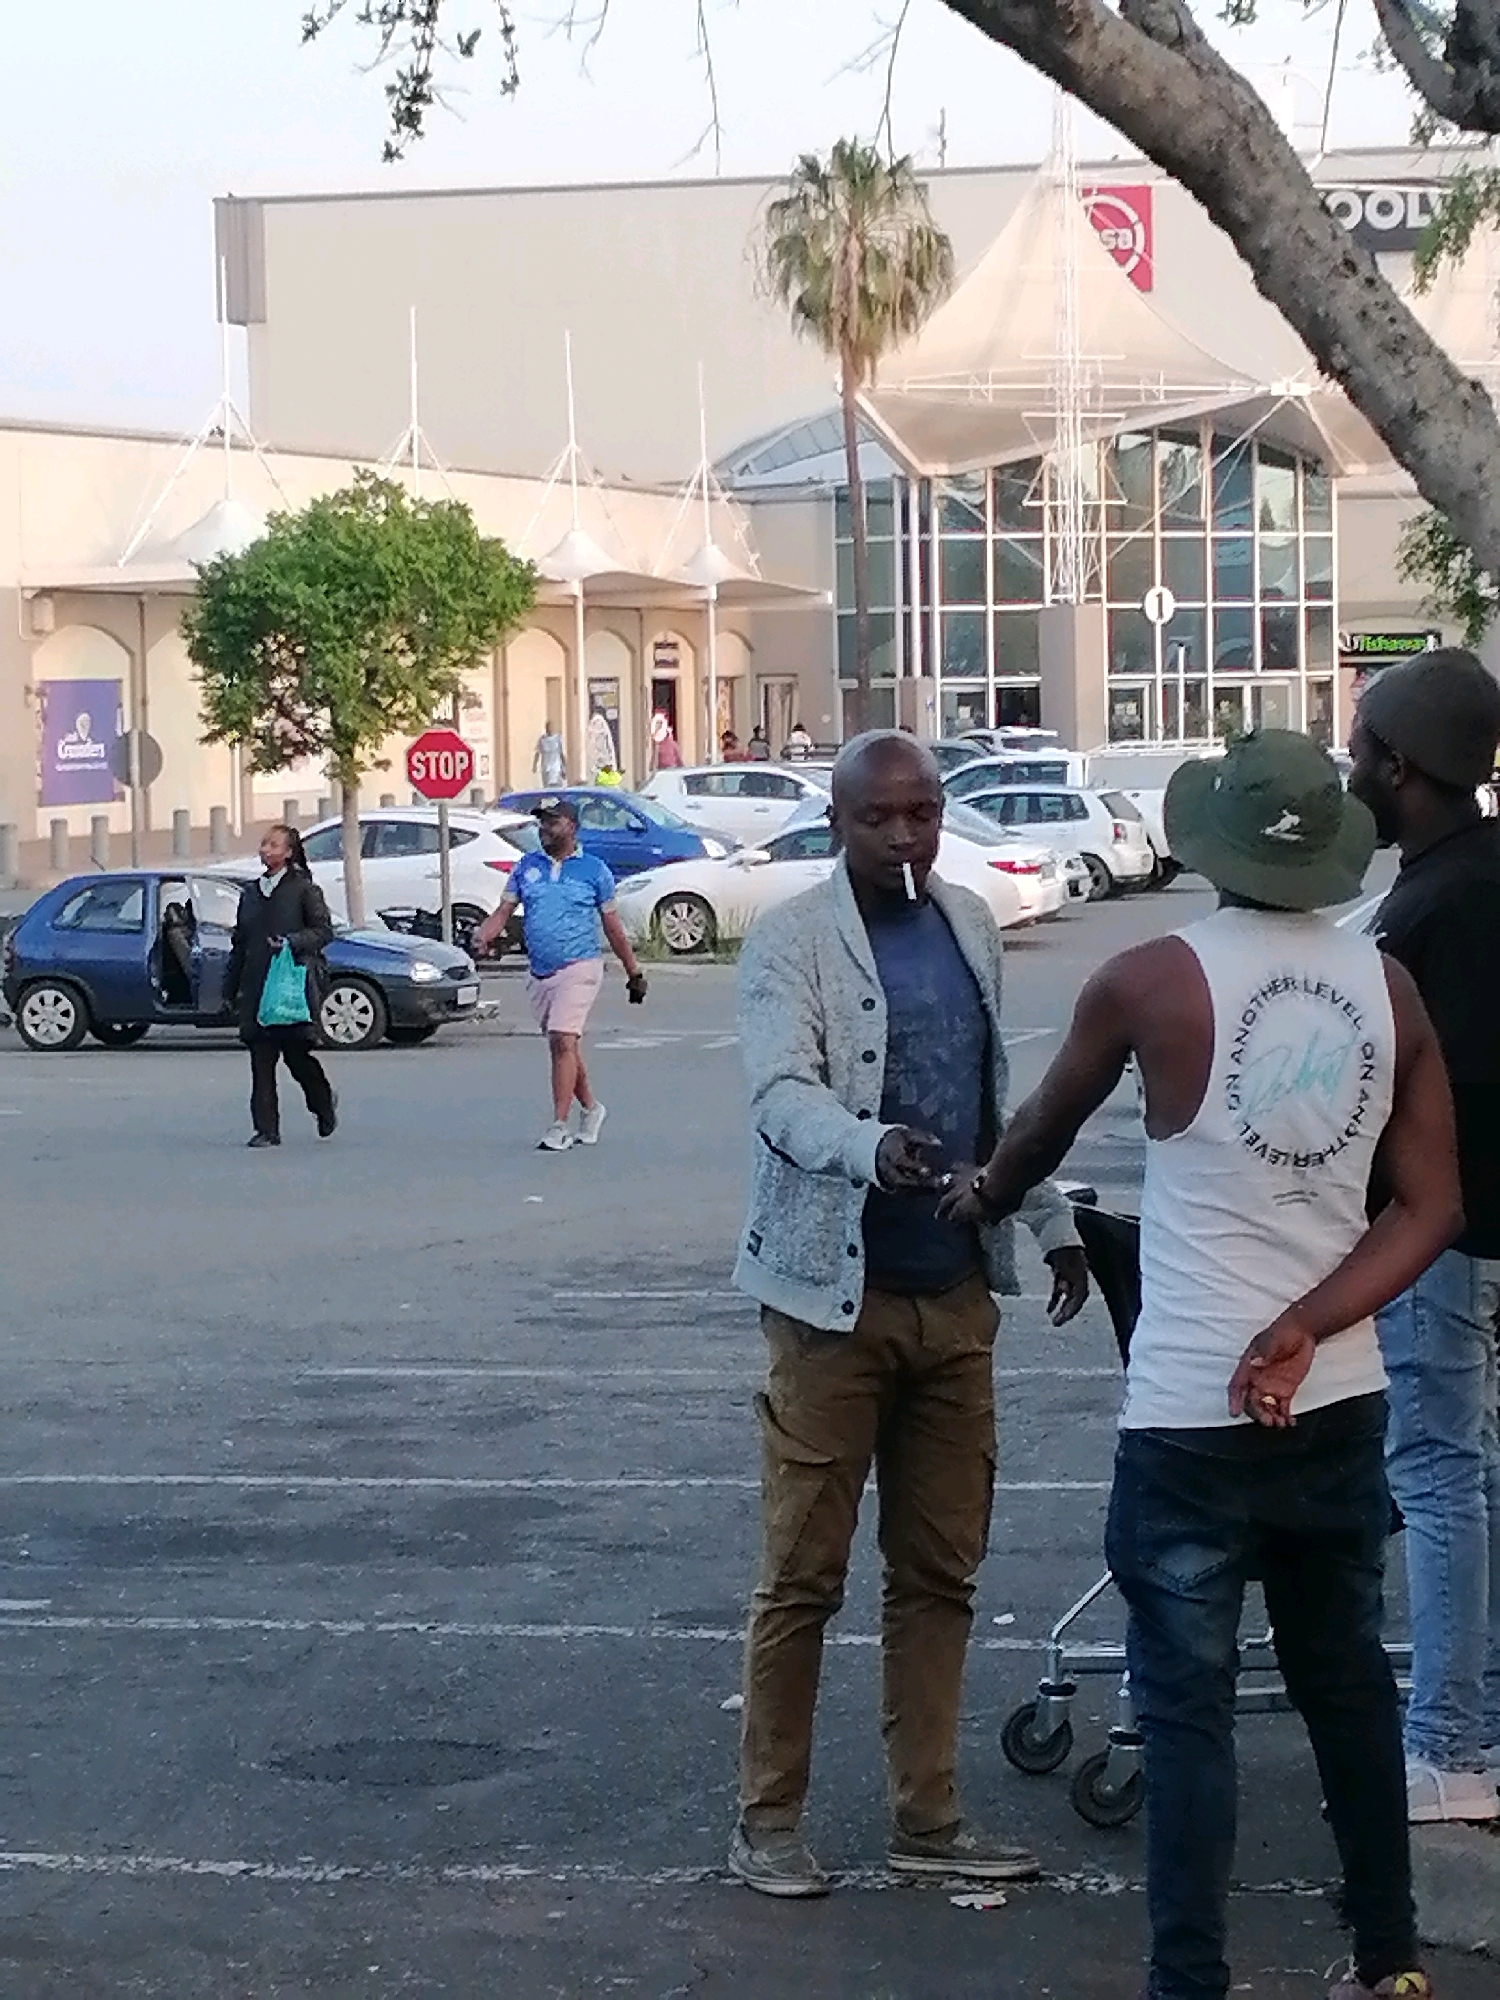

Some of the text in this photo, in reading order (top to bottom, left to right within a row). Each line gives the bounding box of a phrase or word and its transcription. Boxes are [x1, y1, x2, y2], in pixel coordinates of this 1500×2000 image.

[411, 751, 469, 780] STOP
[1230, 976, 1298, 1066] ANOTHER
[1303, 978, 1363, 1031] LEVEL
[1360, 1041, 1375, 1082] ON
[1239, 1122, 1288, 1167] LEVEL
[1293, 1088, 1369, 1168] ANOTHER
